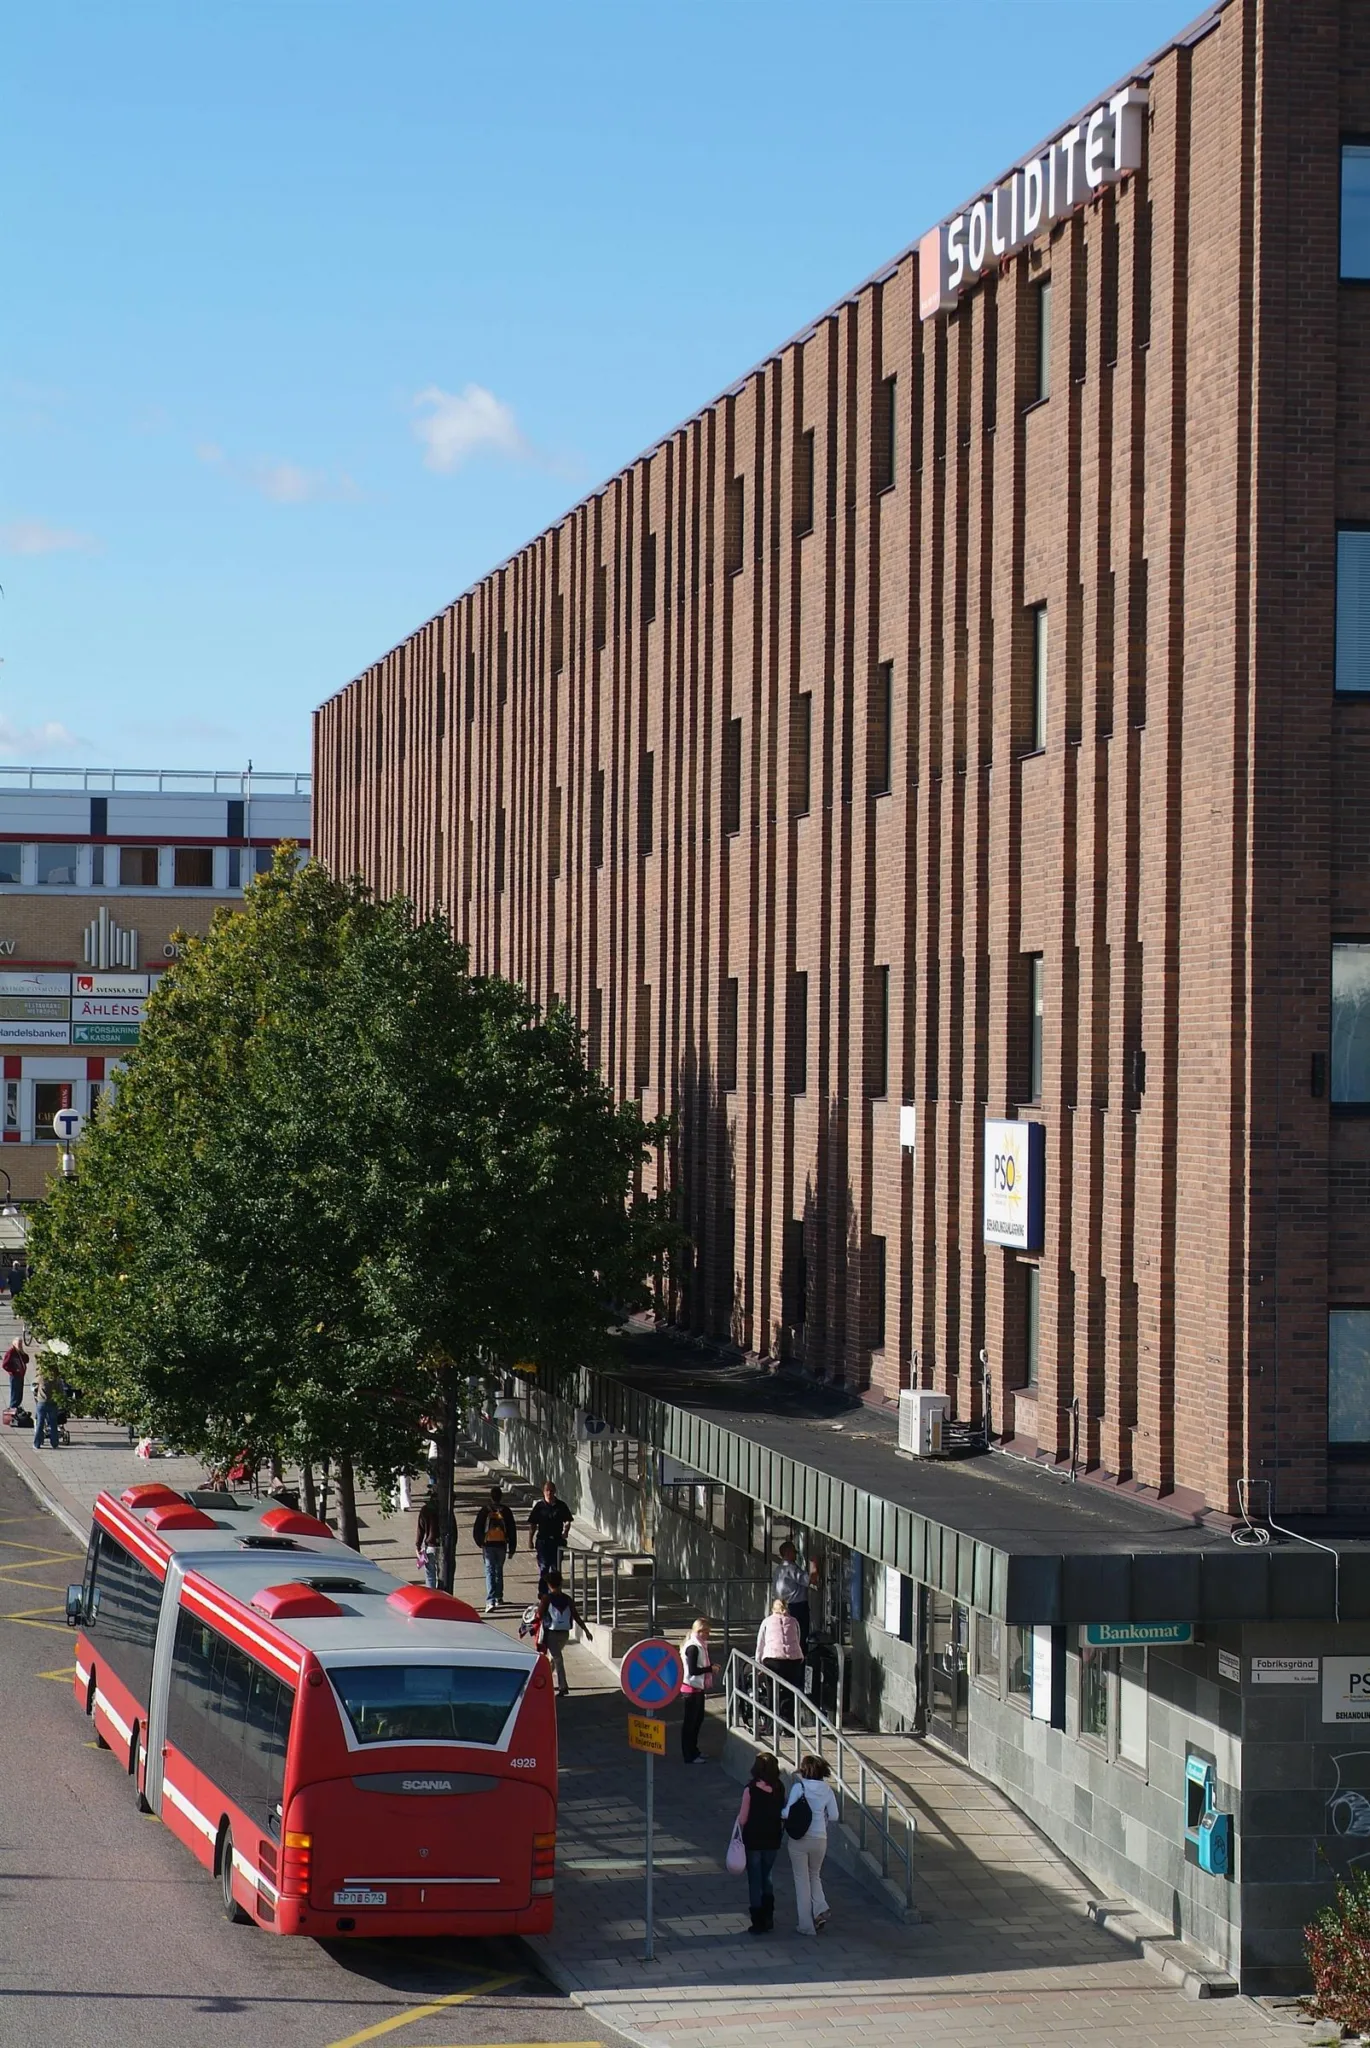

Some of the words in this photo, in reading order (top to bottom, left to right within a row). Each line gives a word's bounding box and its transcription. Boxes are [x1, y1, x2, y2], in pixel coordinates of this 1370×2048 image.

[948, 87, 1130, 291] SOLIDITET
[82, 1001, 139, 1016] ÅHLÉNS
[90, 1026, 140, 1035] FÖRSÄKRING
[90, 1034, 121, 1042] KASSAN
[994, 1154, 1015, 1192] PSO
[1099, 1624, 1180, 1640] Bankomat
[1257, 1660, 1314, 1669] Fabriksgränd
[510, 1757, 537, 1768] 4928
[402, 1779, 452, 1791] SCANIA
